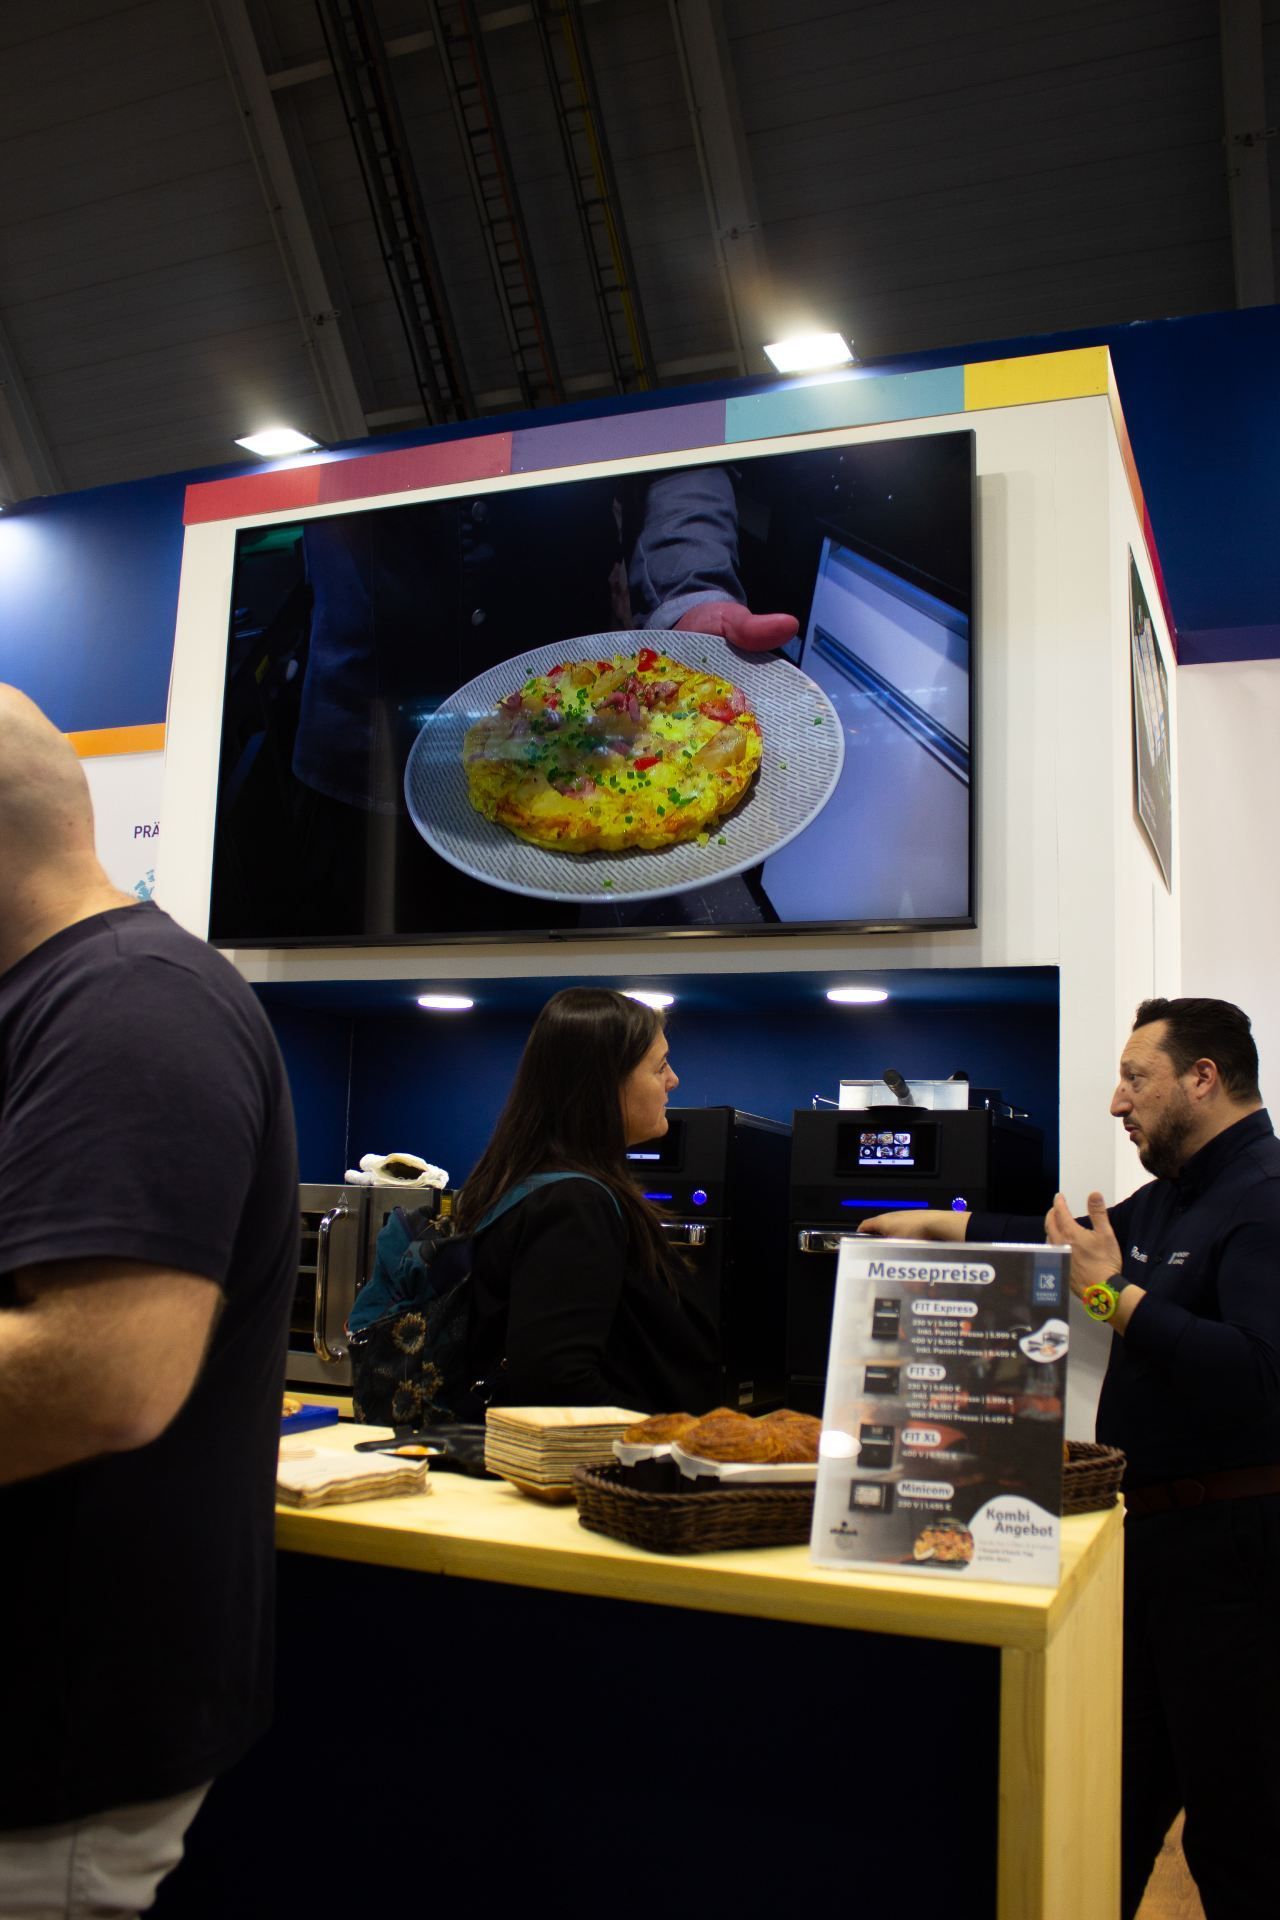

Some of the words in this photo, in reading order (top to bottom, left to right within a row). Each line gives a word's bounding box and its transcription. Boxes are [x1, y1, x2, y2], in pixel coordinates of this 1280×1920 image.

[134, 821, 160, 839] PRÄ
[867, 1262, 990, 1286] Messepreise
[915, 1303, 930, 1311] FIT
[934, 1303, 974, 1315] Express
[910, 1366, 925, 1375] FIT
[929, 1367, 942, 1377] ST
[905, 1432, 920, 1441] FIT
[924, 1433, 937, 1443] XL
[902, 1483, 951, 1496] Miniconv
[986, 1508, 1031, 1523] Kombi
[994, 1522, 1054, 1538] Angebot
